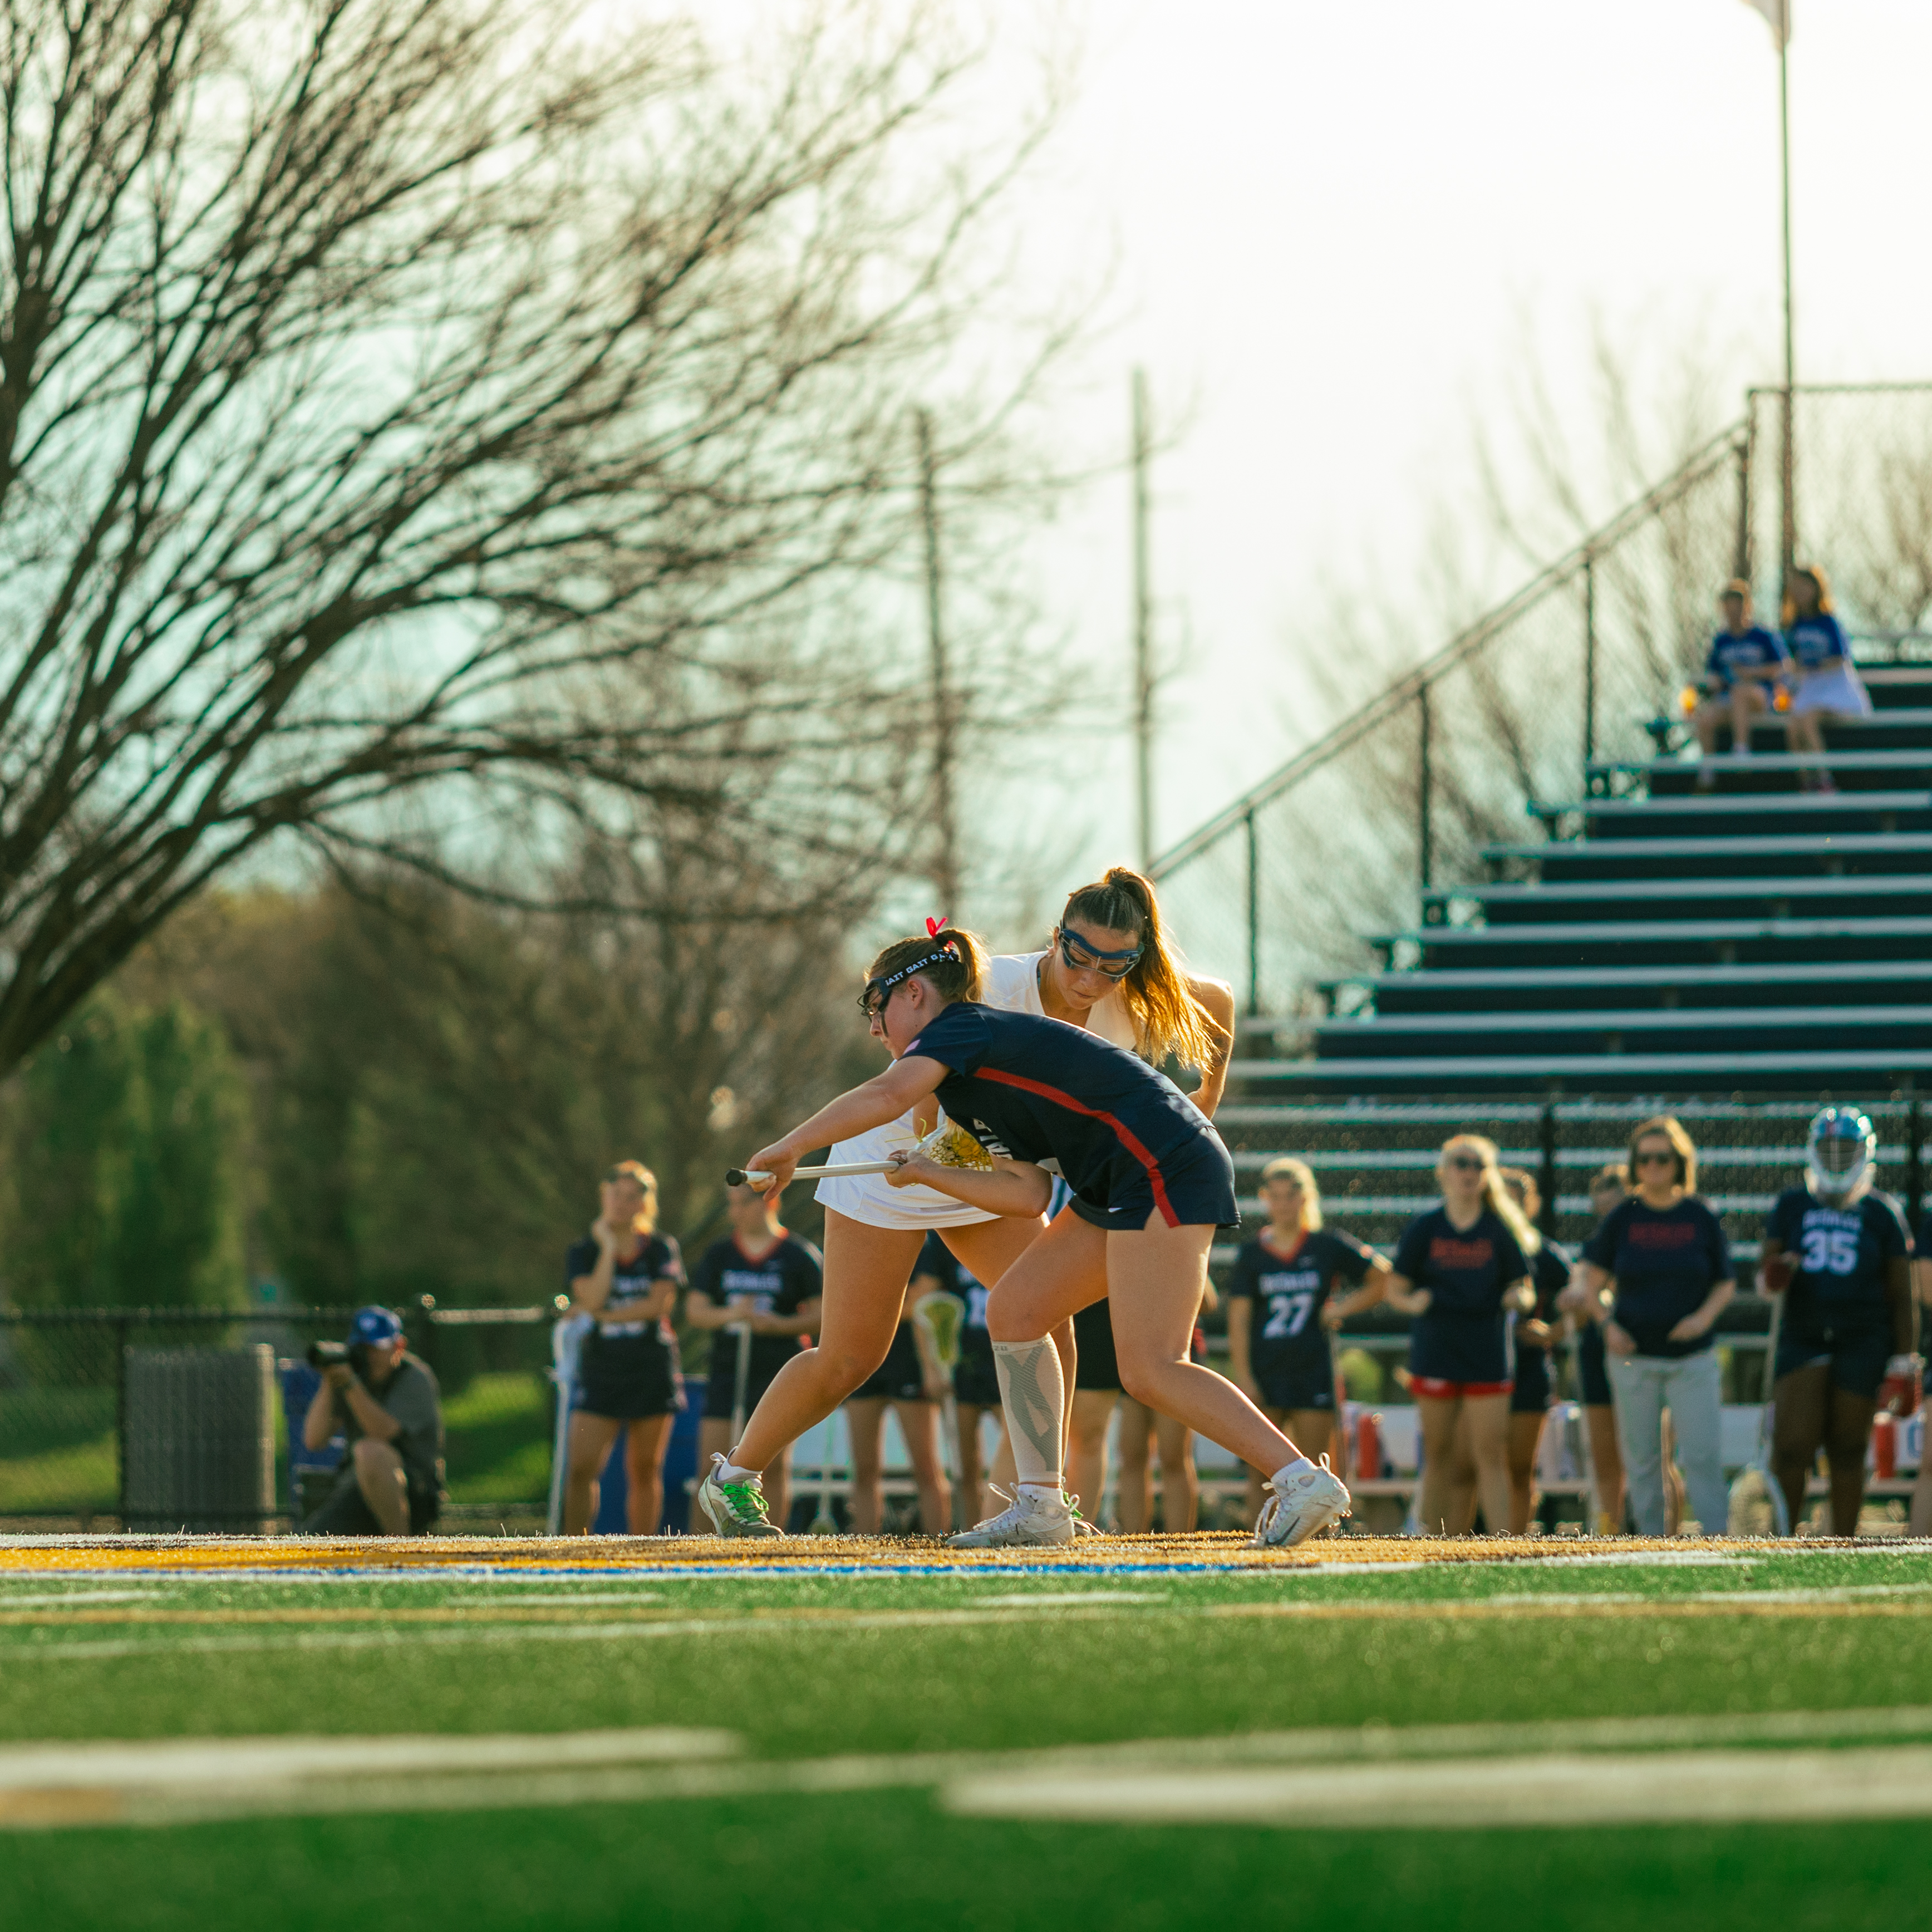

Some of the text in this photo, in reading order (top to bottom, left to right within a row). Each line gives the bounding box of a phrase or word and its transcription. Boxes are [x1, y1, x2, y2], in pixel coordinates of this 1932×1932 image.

[906, 958, 928, 974] GAIT
[1801, 1229, 1857, 1273] 35
[1263, 1293, 1312, 1338] 27
